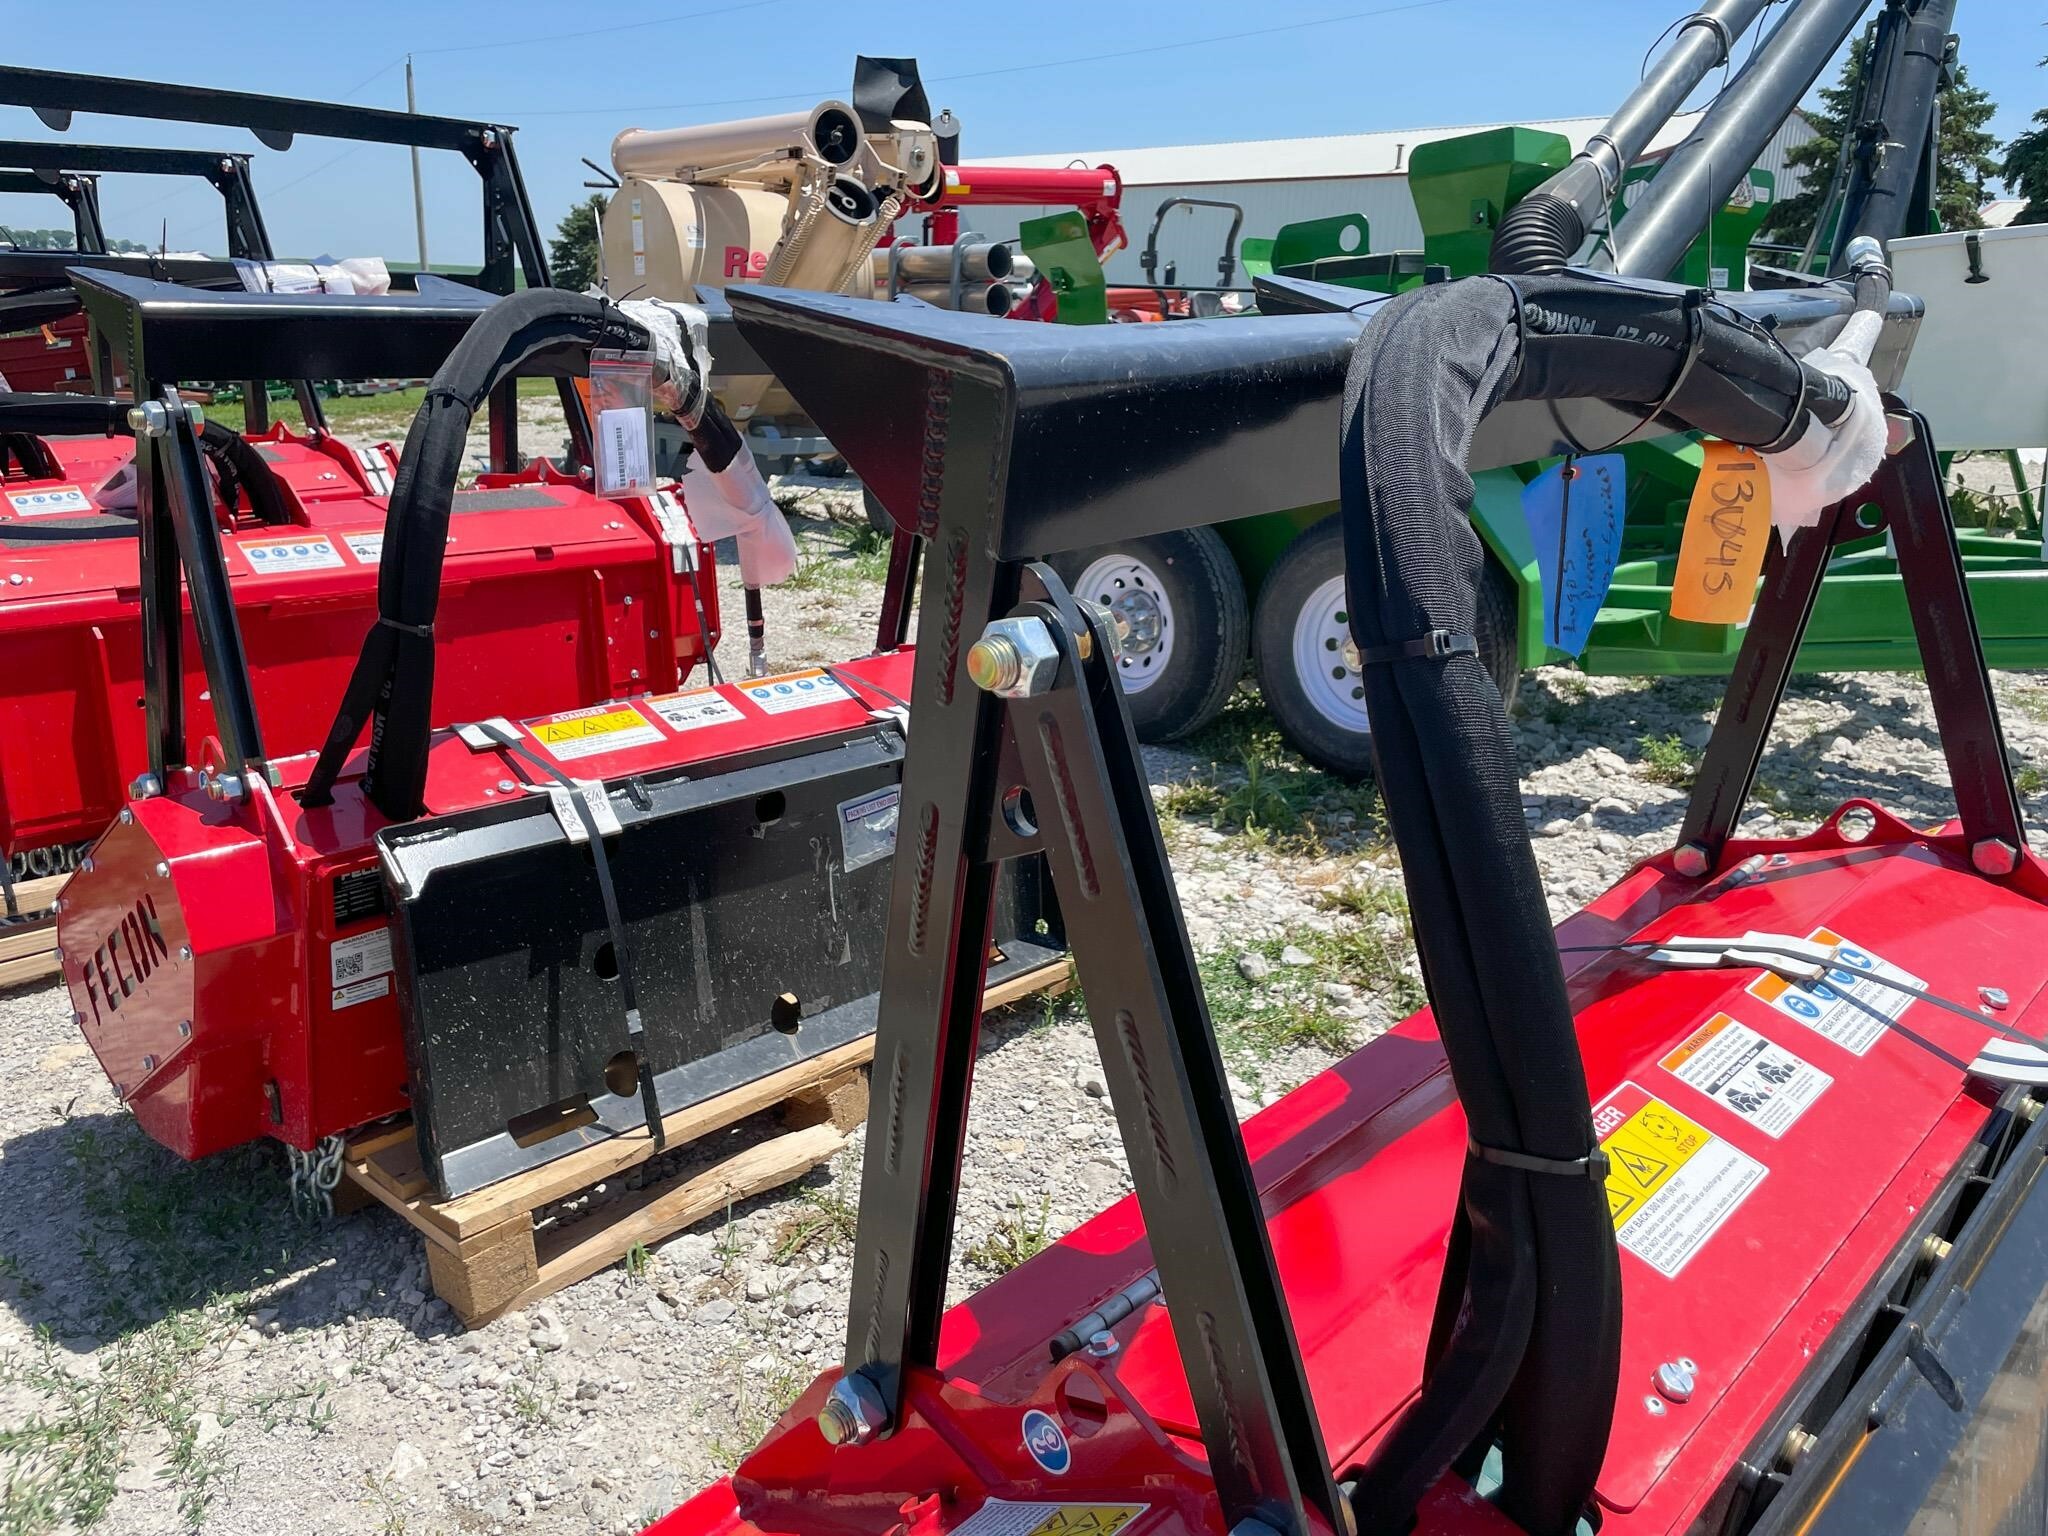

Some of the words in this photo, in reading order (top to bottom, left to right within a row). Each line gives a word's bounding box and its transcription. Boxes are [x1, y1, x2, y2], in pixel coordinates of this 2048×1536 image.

[559, 707, 608, 722] DANGER
[83, 893, 168, 1027] FECON
[1686, 1029, 1714, 1052] WARNING
[1594, 1104, 1627, 1138] GER
[1676, 1134, 1698, 1154] STOP
[1618, 1223, 1638, 1241] STAY
[1631, 1209, 1653, 1228] BACK
[1655, 1191, 1670, 1205] feet
